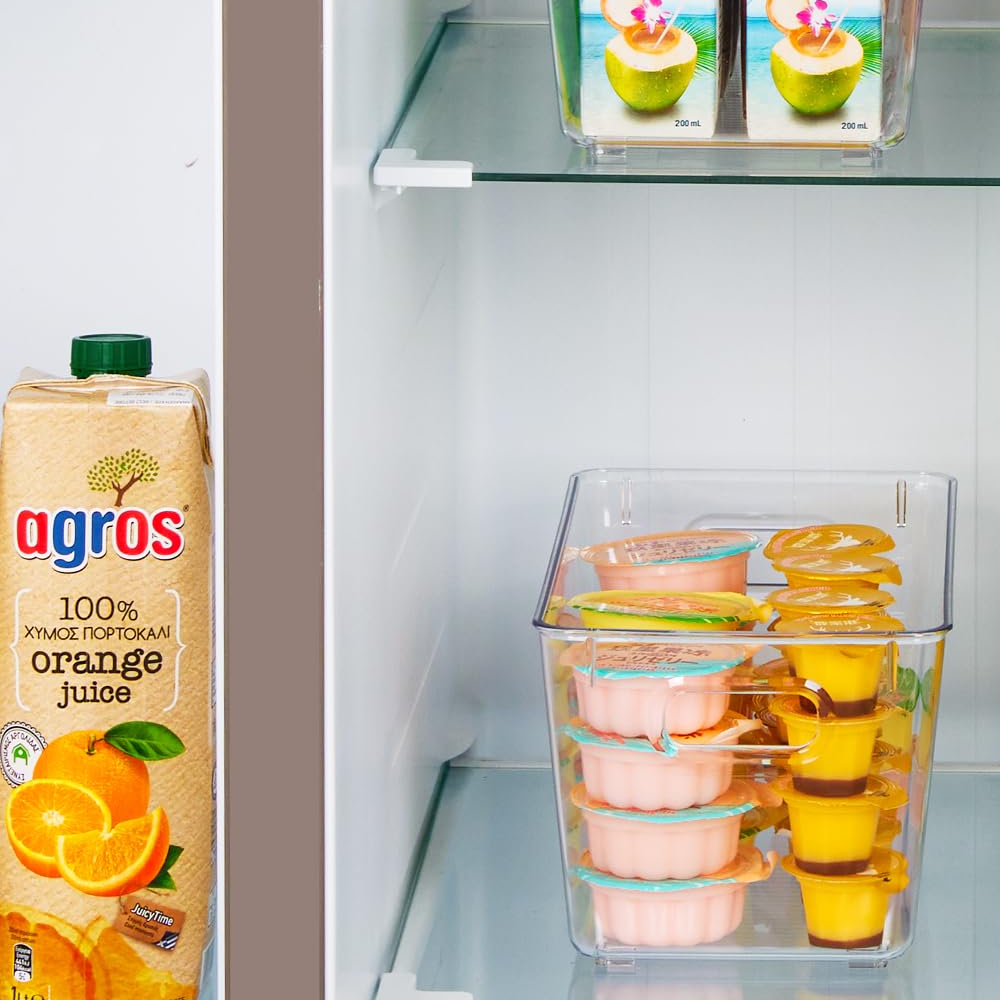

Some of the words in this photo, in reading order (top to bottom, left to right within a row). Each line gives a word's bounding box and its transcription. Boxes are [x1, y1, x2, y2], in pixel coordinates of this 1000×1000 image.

[675, 120, 689, 128] 200
[841, 122, 856, 130] 200
[15, 508, 184, 571] agros
[59, 596, 138, 622] 100%
[31, 648, 163, 681] orange
[57, 681, 131, 709] juice
[131, 903, 174, 926] JuicyTime
